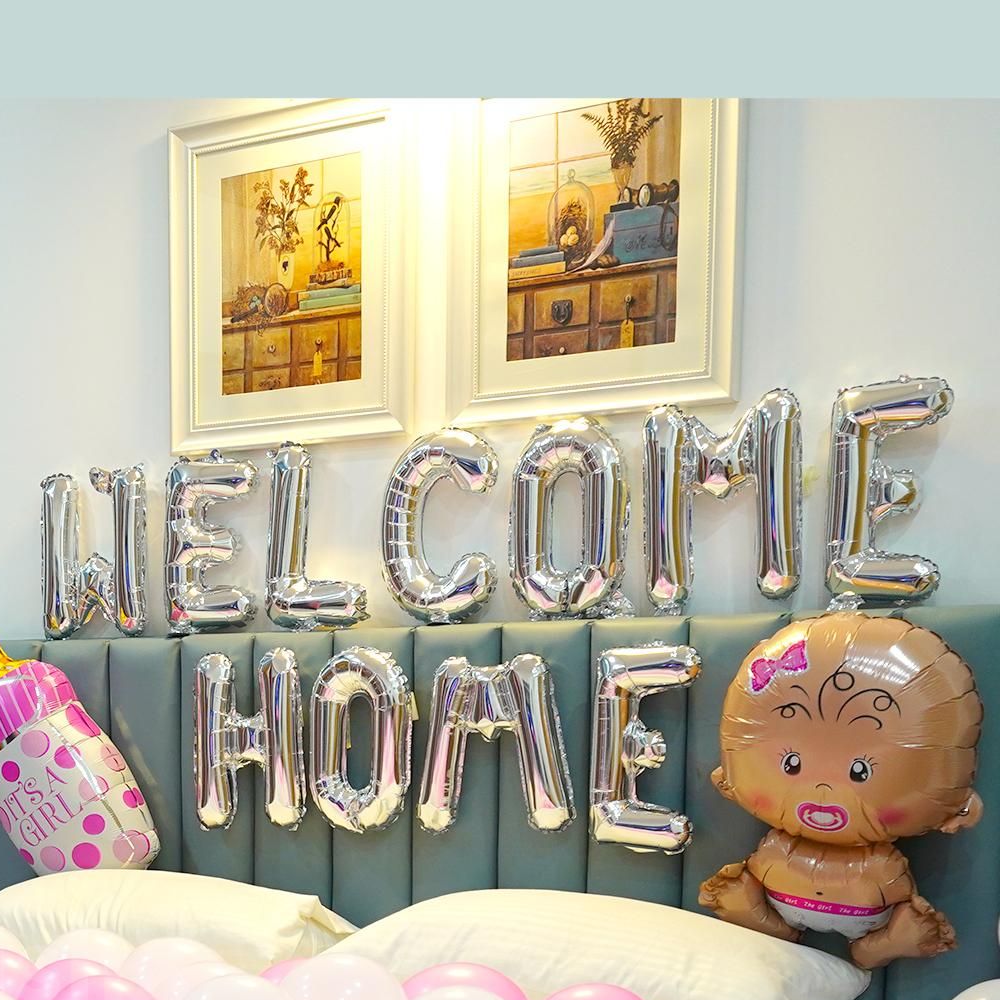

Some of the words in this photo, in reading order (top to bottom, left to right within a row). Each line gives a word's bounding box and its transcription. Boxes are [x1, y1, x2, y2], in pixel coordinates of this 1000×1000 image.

[39, 376, 955, 640] WELCOME
[3, 776, 44, 823] IT'S
[45, 766, 68, 793] A
[191, 641, 703, 854] HOME
[18, 791, 85, 847] GIRL
